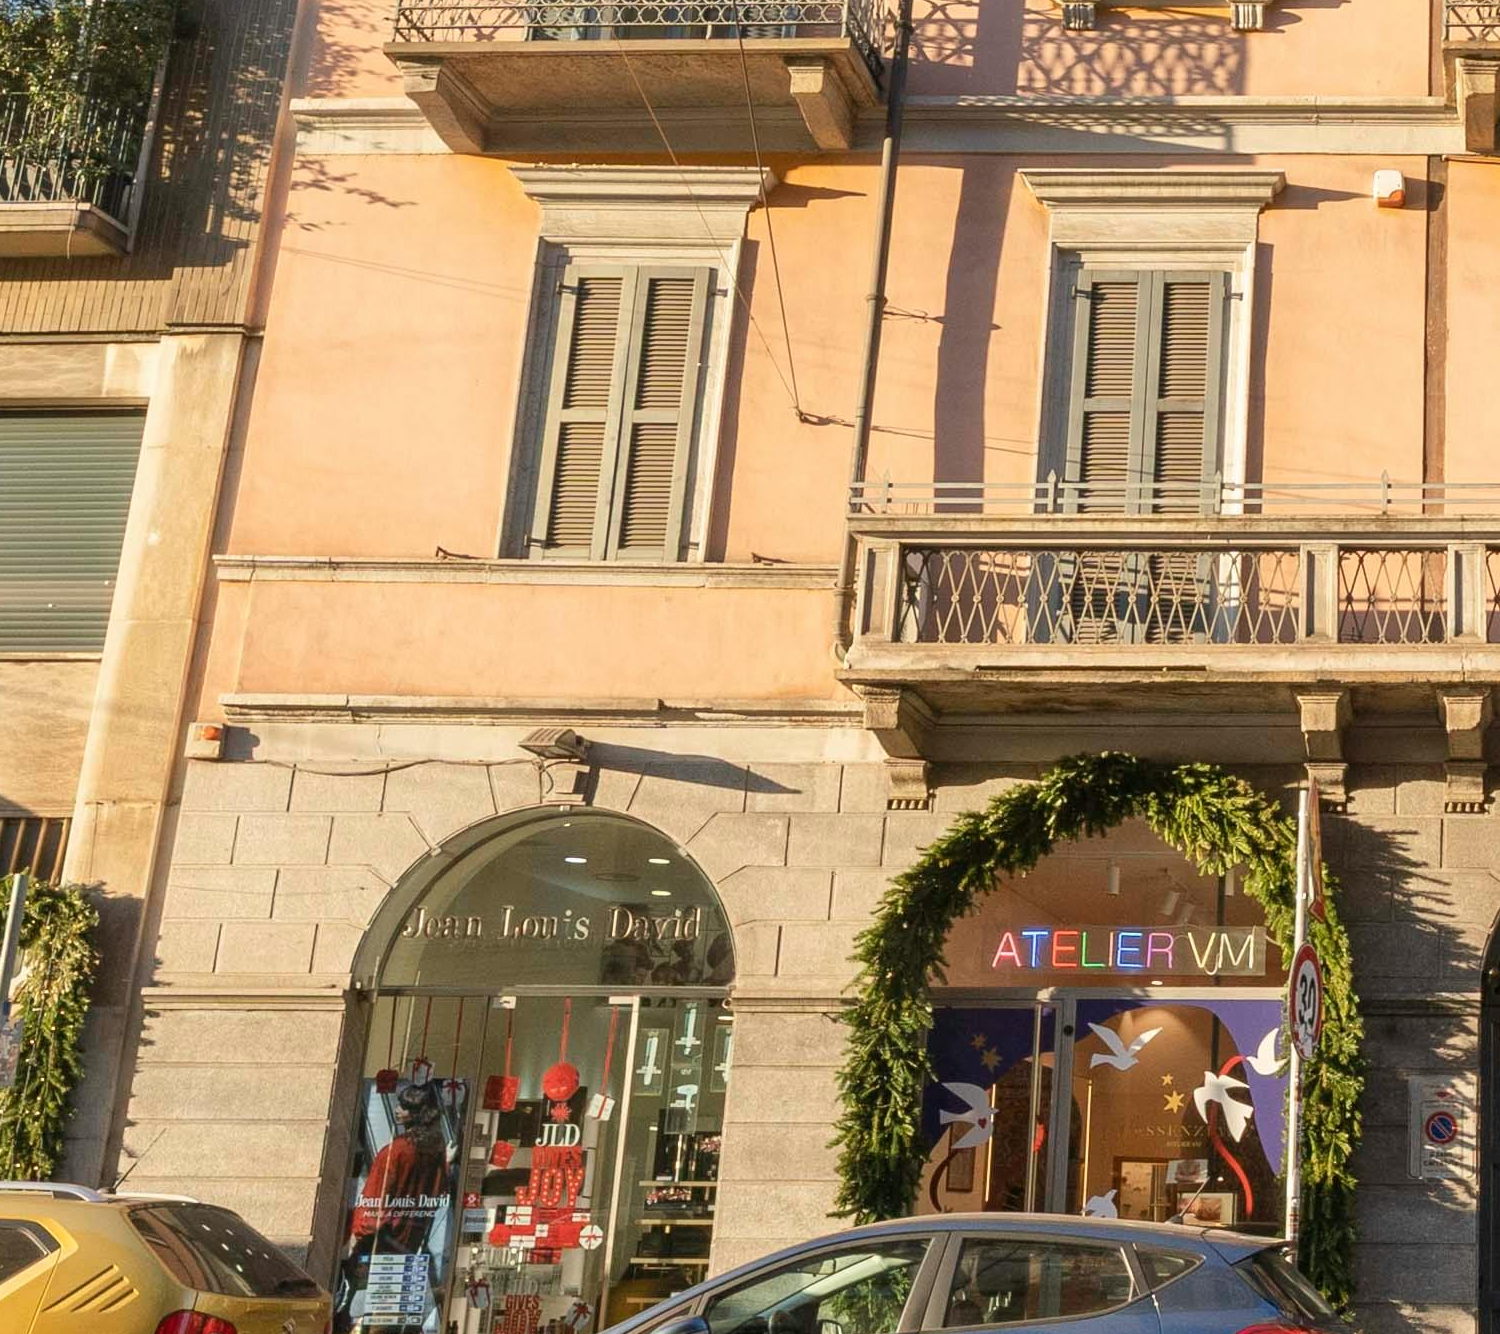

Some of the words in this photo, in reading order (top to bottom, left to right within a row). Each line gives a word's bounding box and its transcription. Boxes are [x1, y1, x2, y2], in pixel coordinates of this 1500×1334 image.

[401, 905, 483, 940] Jean
[500, 905, 591, 940] Louis
[608, 905, 701, 940] David
[991, 929, 1175, 969] ATELIER
[1186, 930, 1256, 971] VM
[1298, 973, 1317, 1027] 30
[534, 1123, 581, 1147] JLD
[354, 1194, 382, 1208] Jean
[385, 1194, 415, 1208] Louis
[418, 1194, 450, 1208] David
[516, 1167, 585, 1208] JOY
[505, 1294, 541, 1310] GIVES
